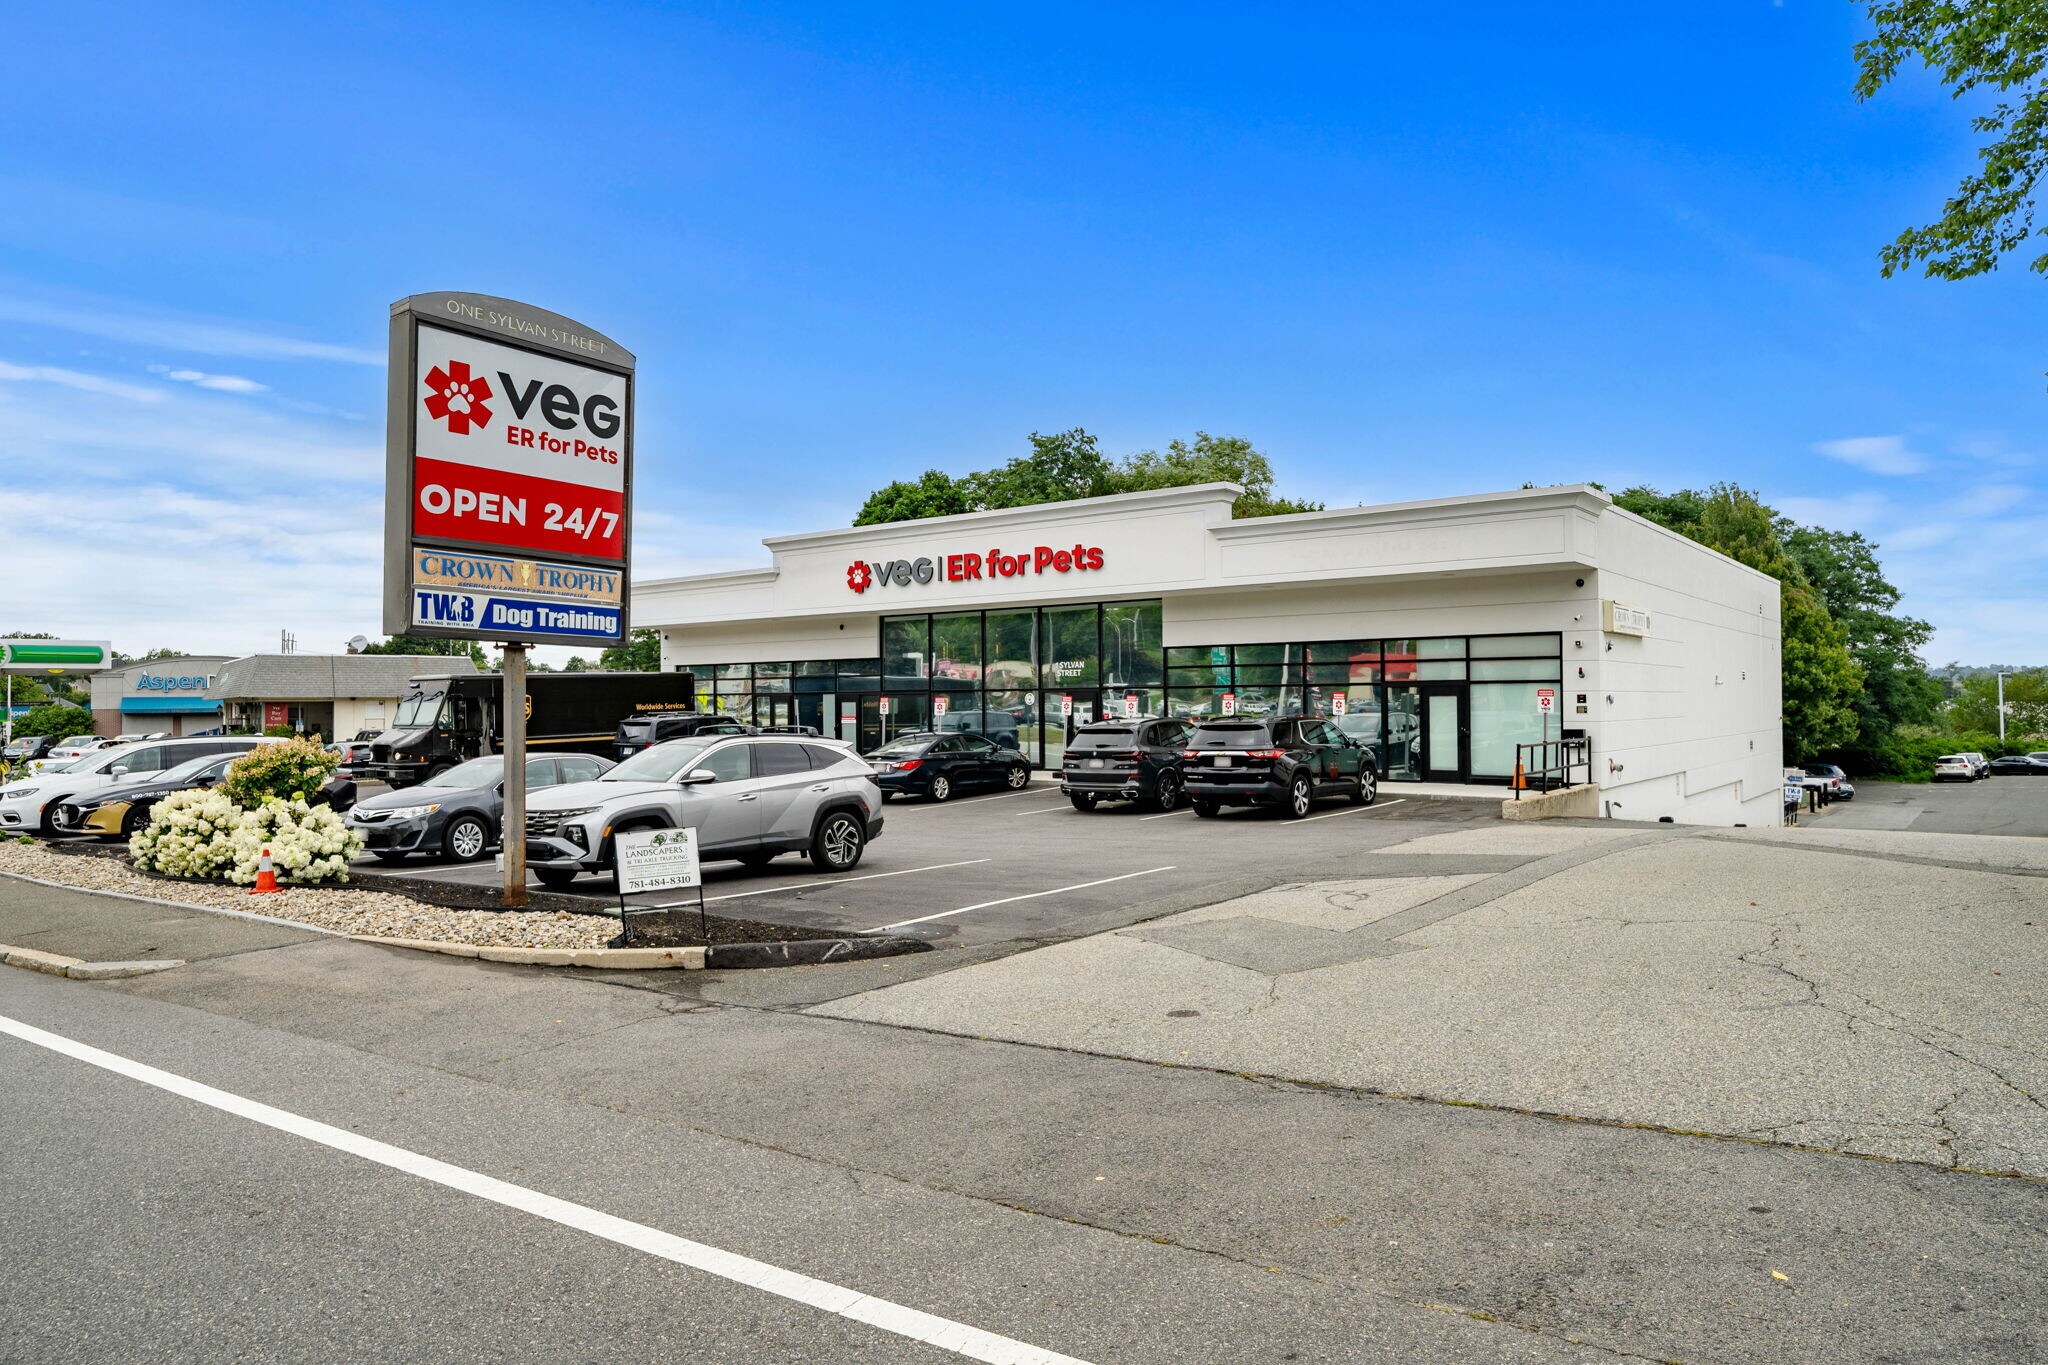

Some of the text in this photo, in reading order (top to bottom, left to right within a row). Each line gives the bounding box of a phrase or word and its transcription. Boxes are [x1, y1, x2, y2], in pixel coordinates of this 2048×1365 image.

[447, 300, 607, 354] ONE SYLVAN STREET
[507, 425, 618, 464] ER for Pets
[420, 484, 620, 540] OPEN 24/7
[947, 552, 983, 582] ER
[985, 548, 1031, 579] for
[1034, 543, 1104, 575] Pets
[420, 555, 618, 593] CROWN TROPHY
[457, 581, 497, 590] AMERICA'S
[492, 604, 618, 634] Dog Training
[1057, 669, 1082, 677] STREET
[1060, 661, 1085, 669] SYLVAN
[635, 702, 686, 711] Worldwide Services
[625, 846, 683, 858] LANDSCAPERS
[629, 876, 691, 889] 781-484-8310
